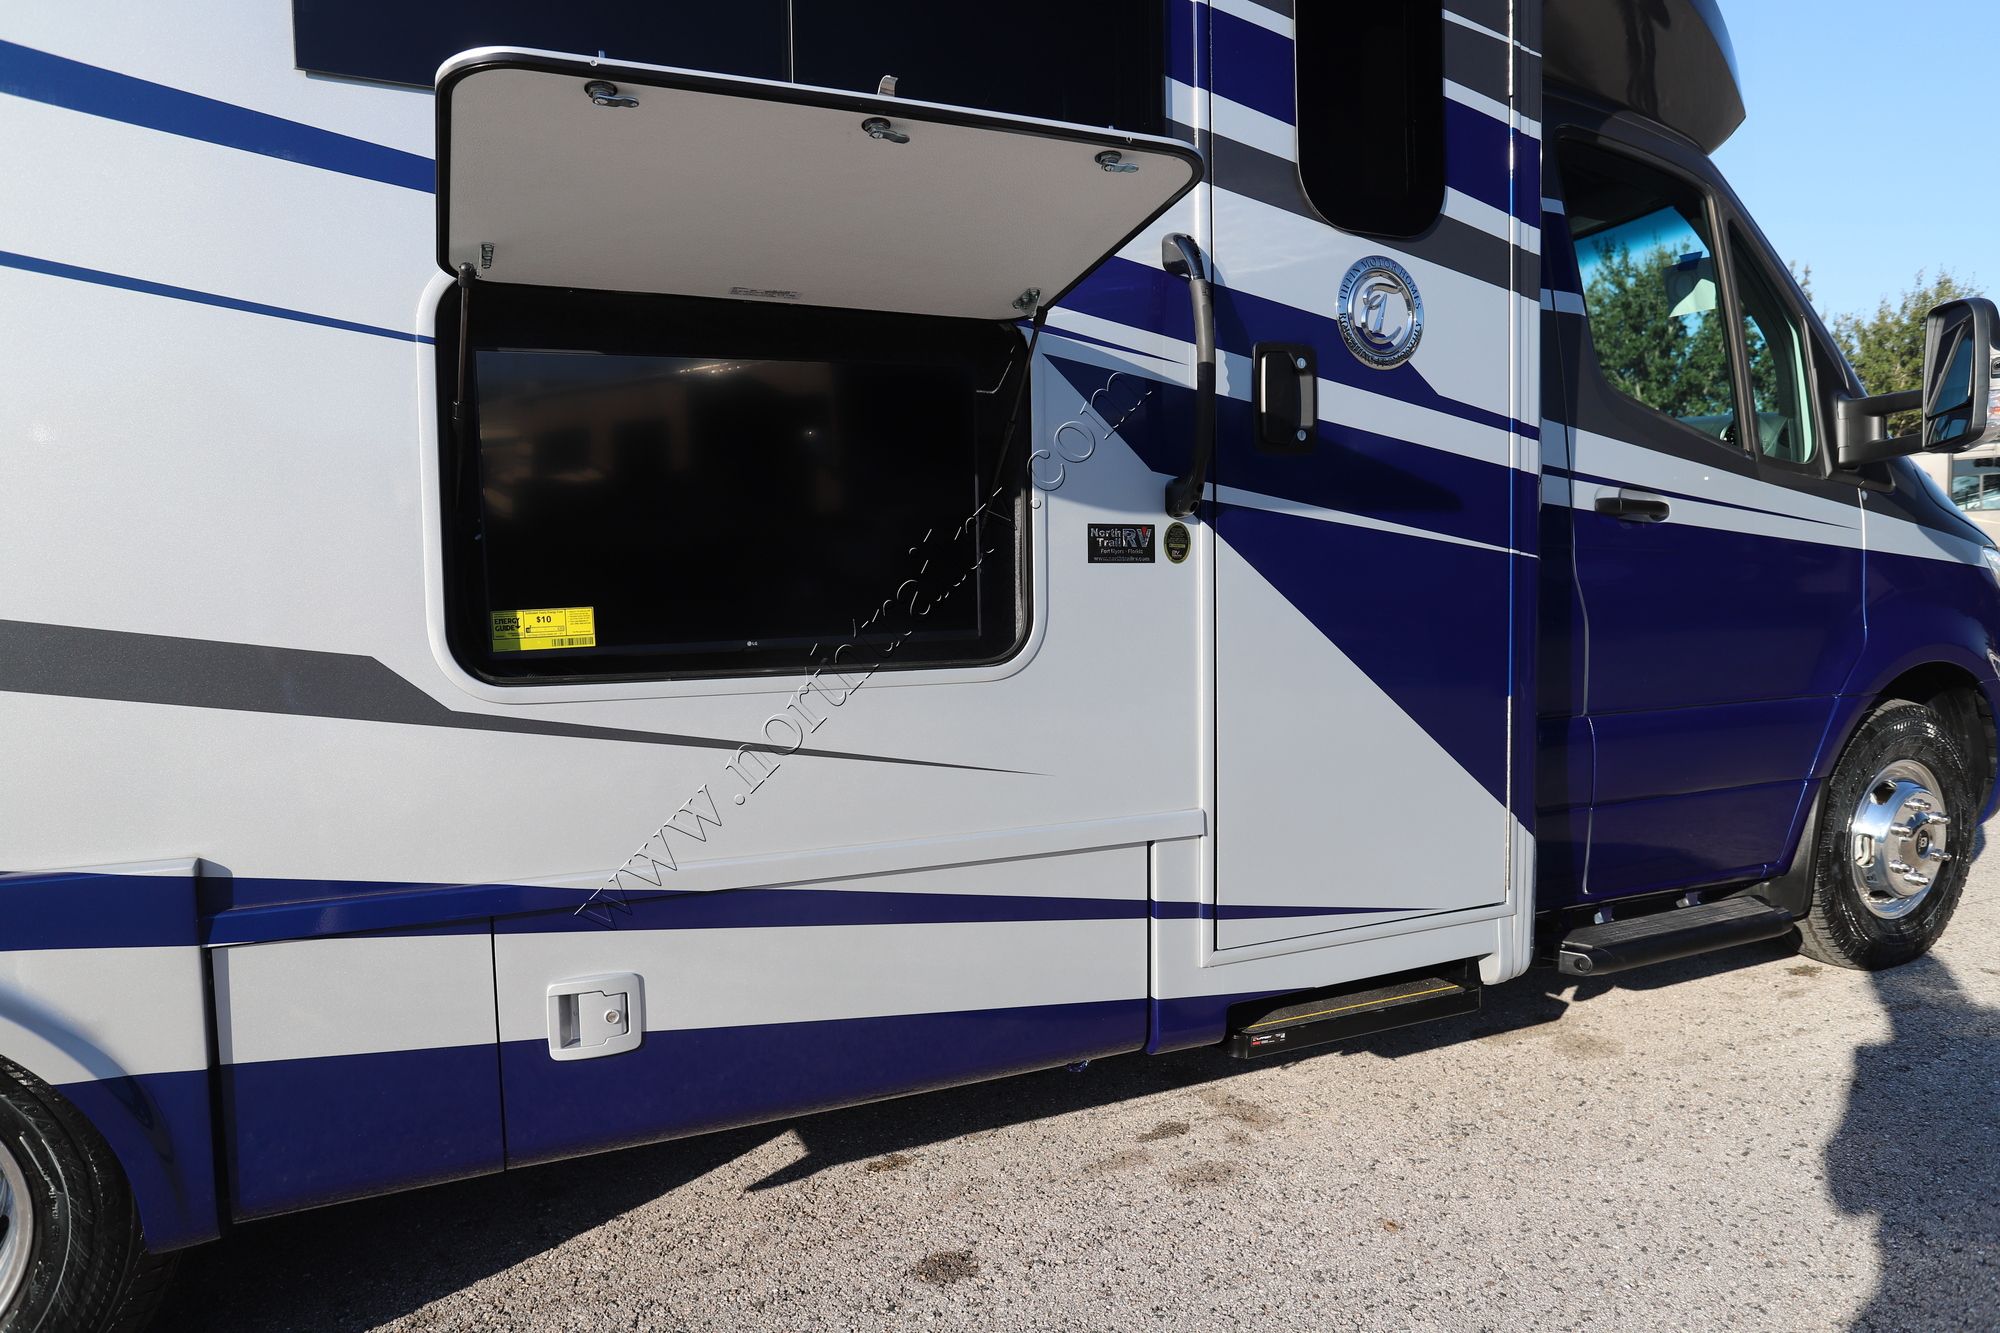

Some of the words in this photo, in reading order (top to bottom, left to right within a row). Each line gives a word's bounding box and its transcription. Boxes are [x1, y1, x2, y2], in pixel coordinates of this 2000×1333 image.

[1090, 527, 1121, 538] North
[1096, 537, 1121, 547] Trail
[1122, 527, 1152, 548] RV
[494, 617, 520, 626] ENERGY
[536, 615, 552, 624] $10
[494, 624, 516, 632] GUIDE
